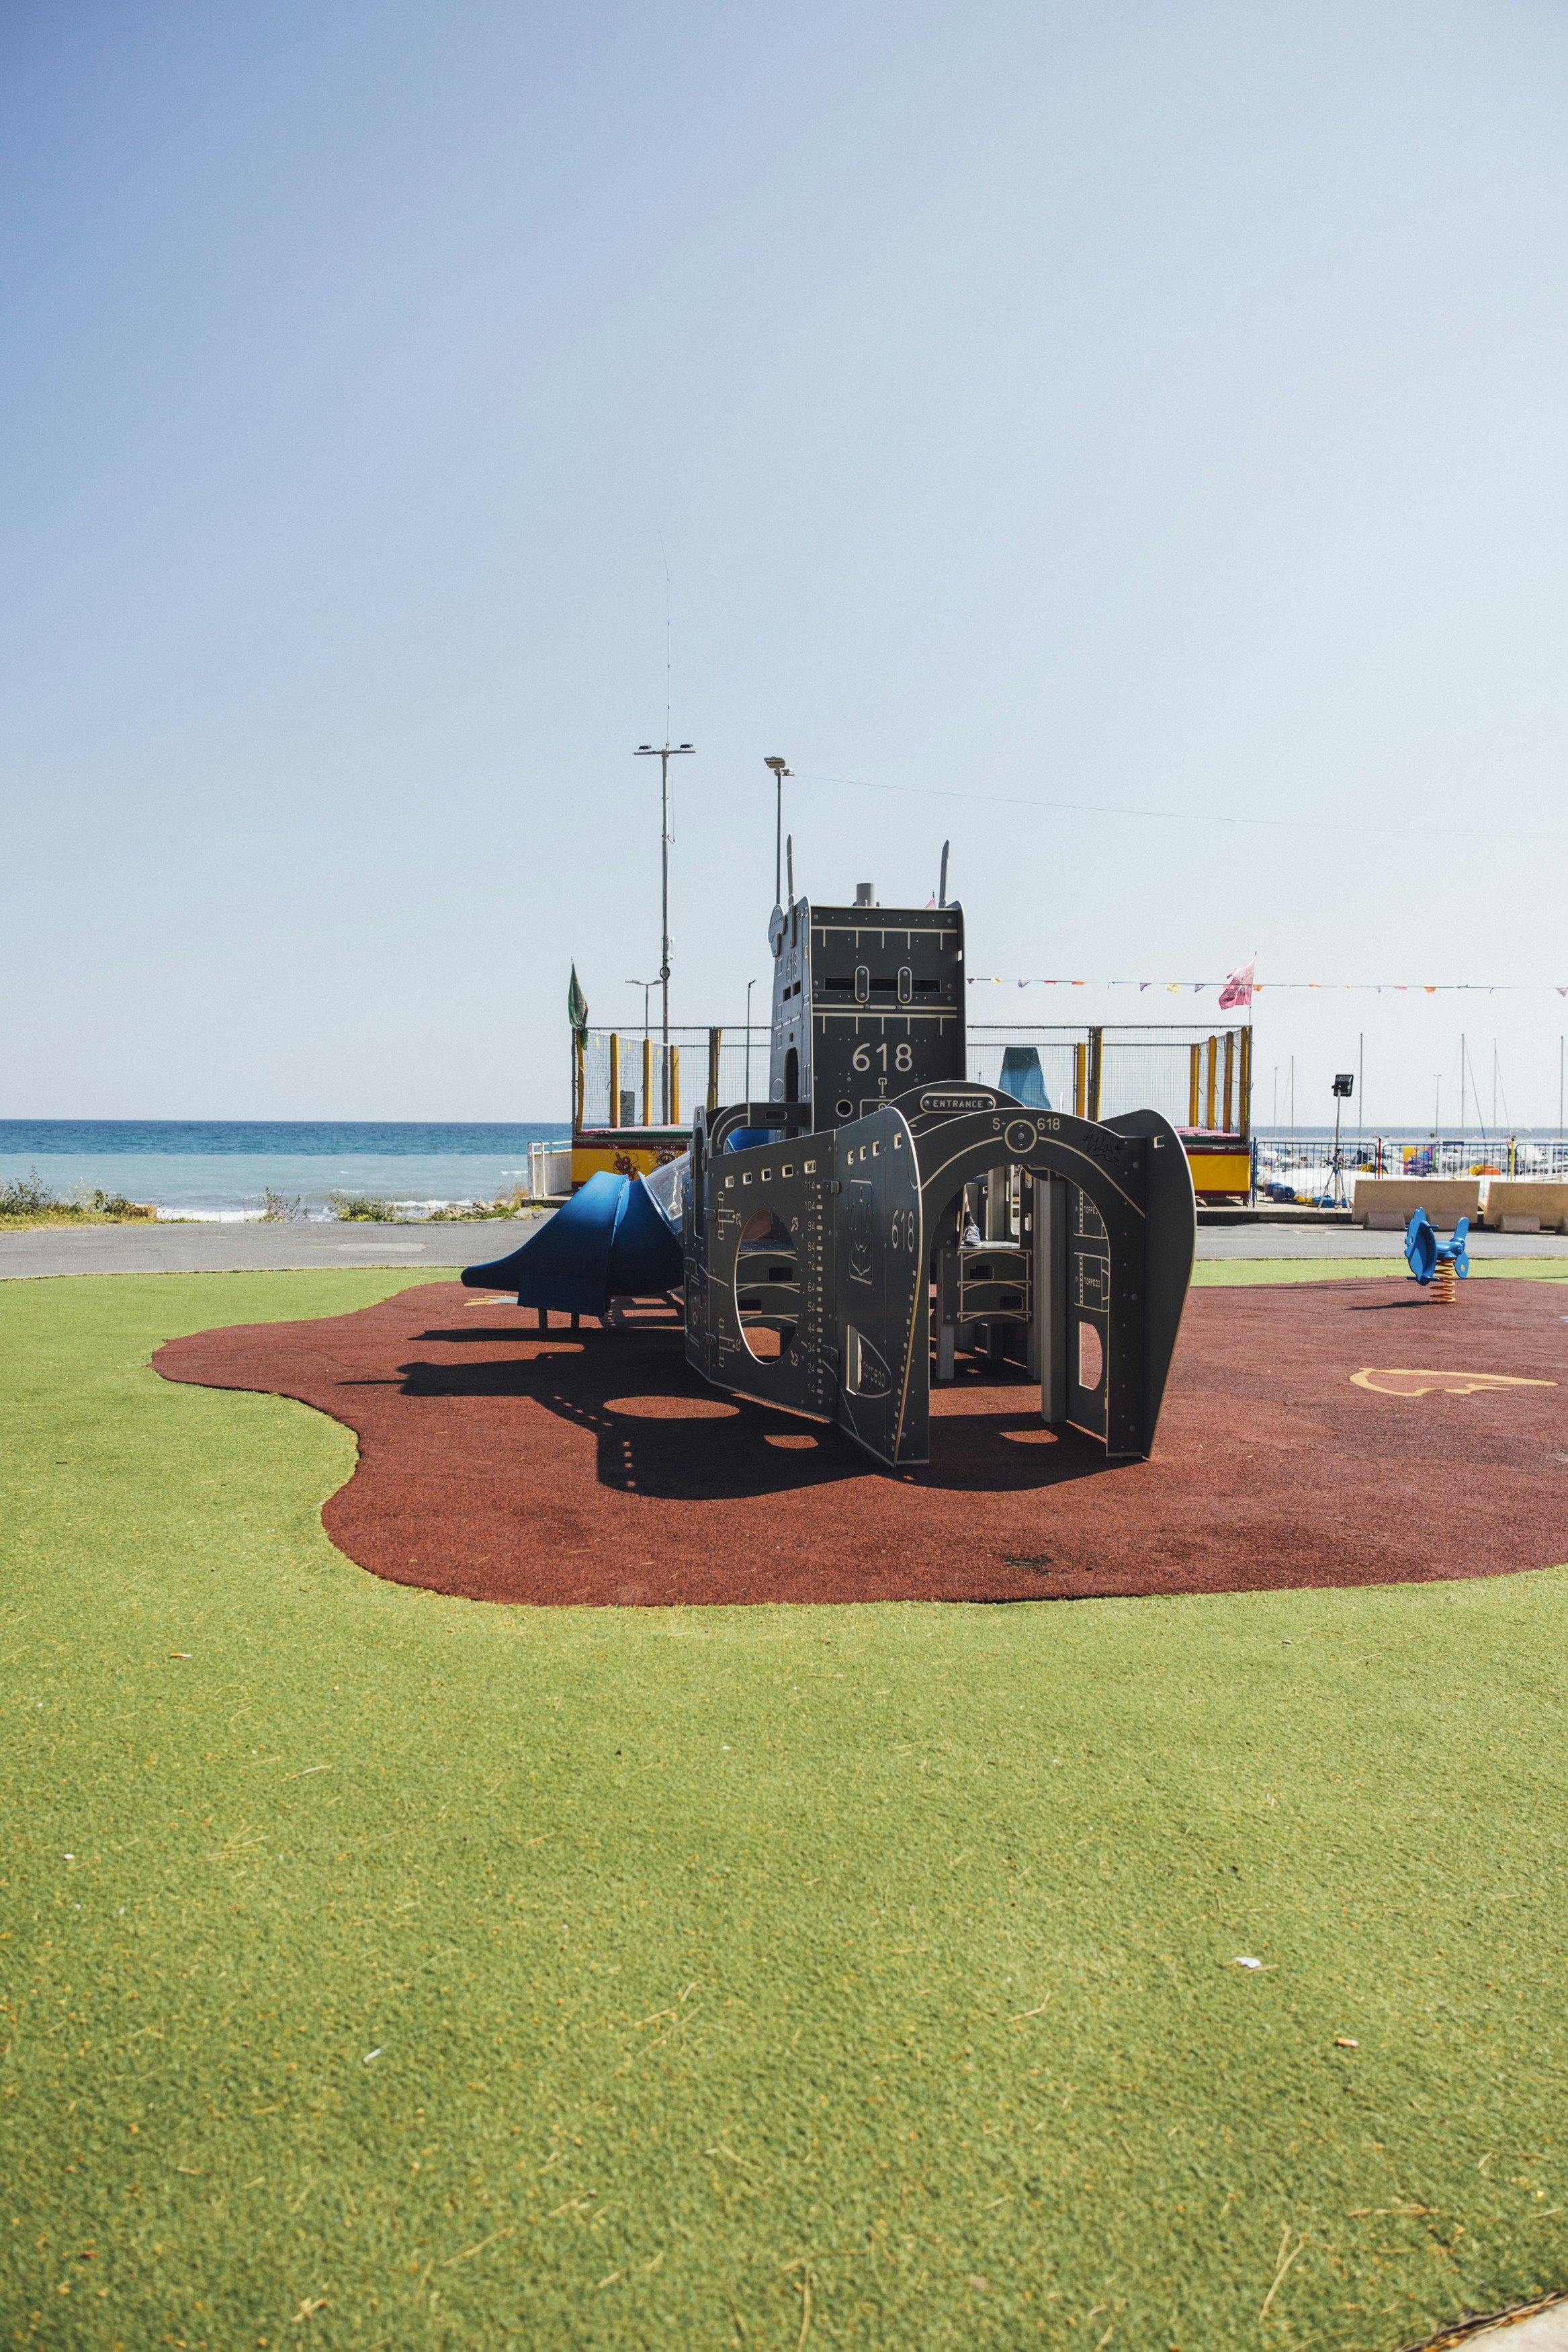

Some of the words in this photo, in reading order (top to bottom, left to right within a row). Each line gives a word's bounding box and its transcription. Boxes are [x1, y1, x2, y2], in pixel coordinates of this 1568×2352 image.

[786, 950, 797, 983] 618
[853, 1043, 912, 1072] 618
[932, 1099, 984, 1108] ENTRANCE
[992, 1118, 1006, 1130] S-
[1037, 1118, 1061, 1130] 618
[805, 1181, 815, 1191] 114
[805, 1200, 815, 1212] 104
[1084, 1206, 1098, 1214] TORPED
[808, 1220, 815, 1232] 94
[891, 1209, 914, 1253] 618
[808, 1241, 815, 1252] 84
[808, 1261, 815, 1272] 74
[808, 1282, 815, 1293] 64
[1084, 1277, 1100, 1288] TORPEDO
[808, 1302, 815, 1312] 54
[808, 1322, 815, 1333] 44
[808, 1342, 815, 1353] 34
[808, 1362, 815, 1374] 24
[863, 1360, 885, 1389] torpedo
[808, 1383, 815, 1394] 14
